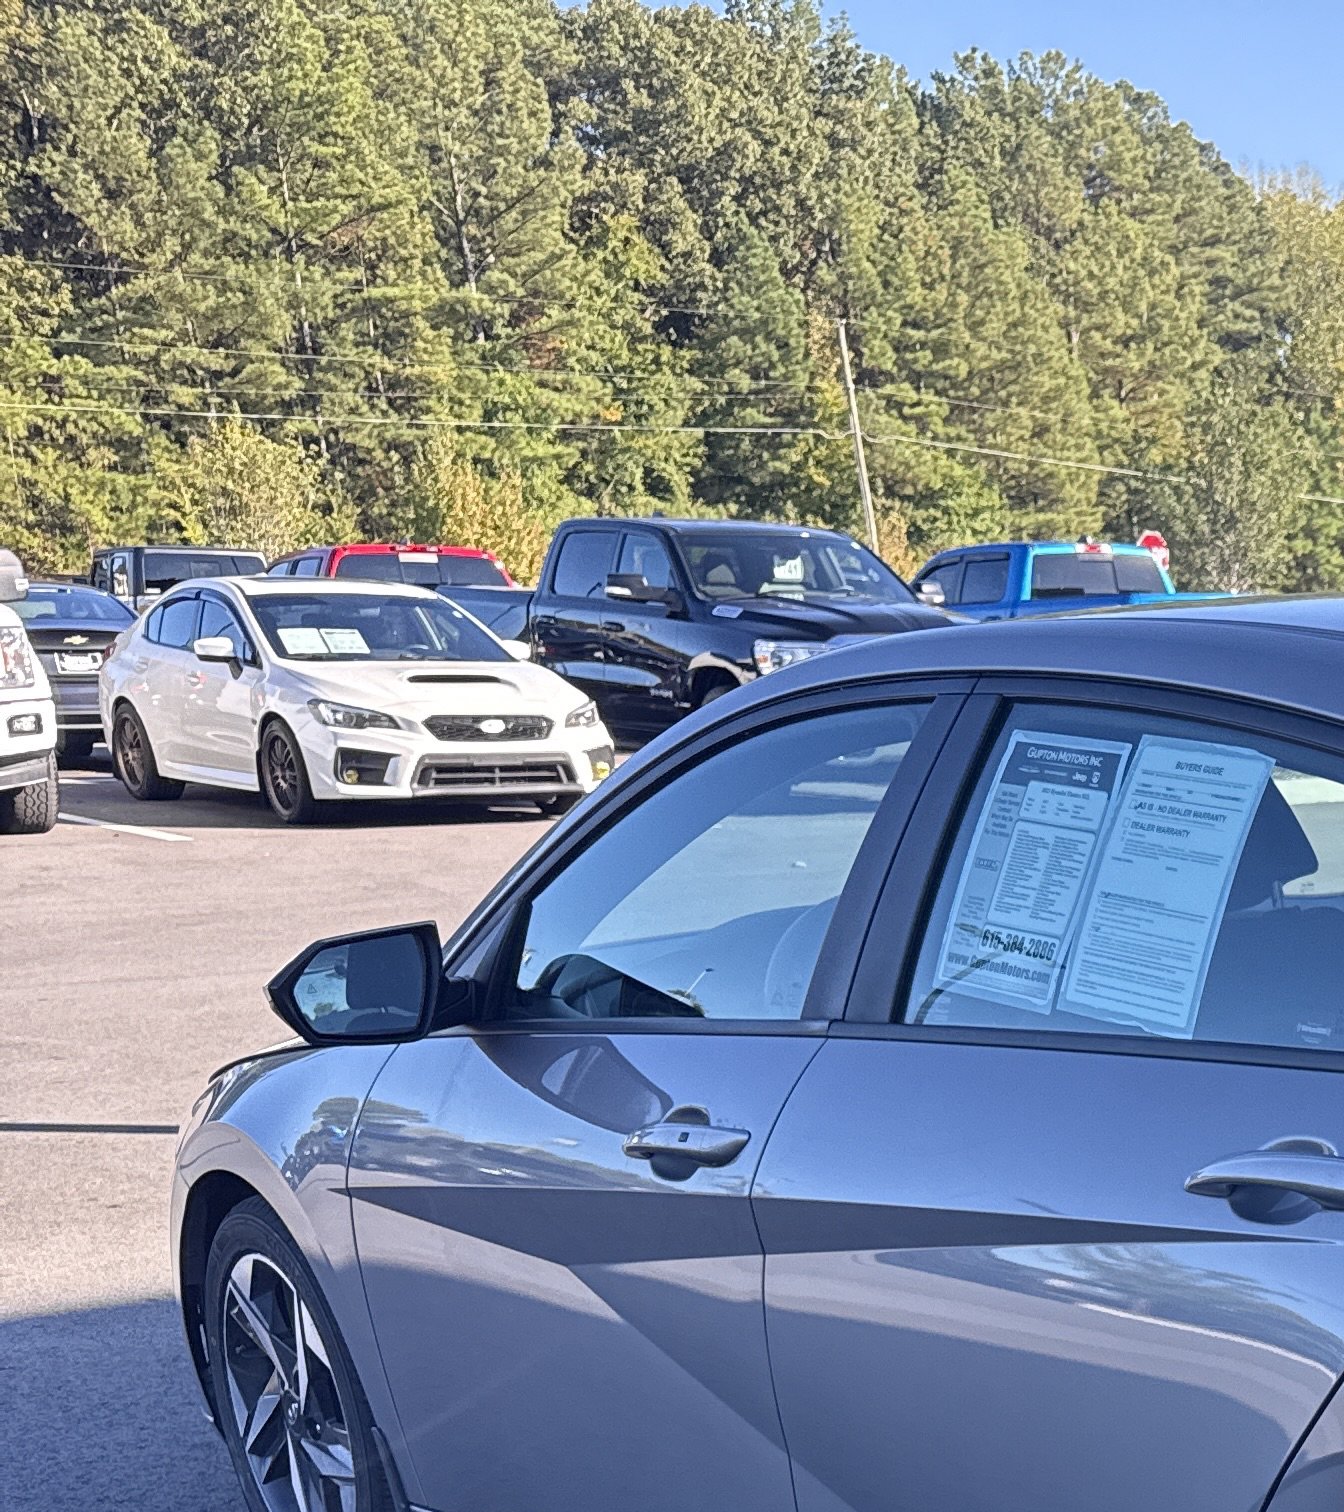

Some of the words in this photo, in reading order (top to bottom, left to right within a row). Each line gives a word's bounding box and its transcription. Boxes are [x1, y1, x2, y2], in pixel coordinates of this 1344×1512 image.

[1026, 746, 1058, 761] GUPTON
[1058, 750, 1090, 766] MOTORS
[1175, 761, 1203, 773] BUYERS
[1202, 763, 1225, 776] GUIDE
[1167, 804, 1193, 818] DEALER
[1192, 808, 1227, 824] WARRANTY
[1130, 821, 1155, 833] DEALER
[1155, 823, 1190, 838] WARRANTY
